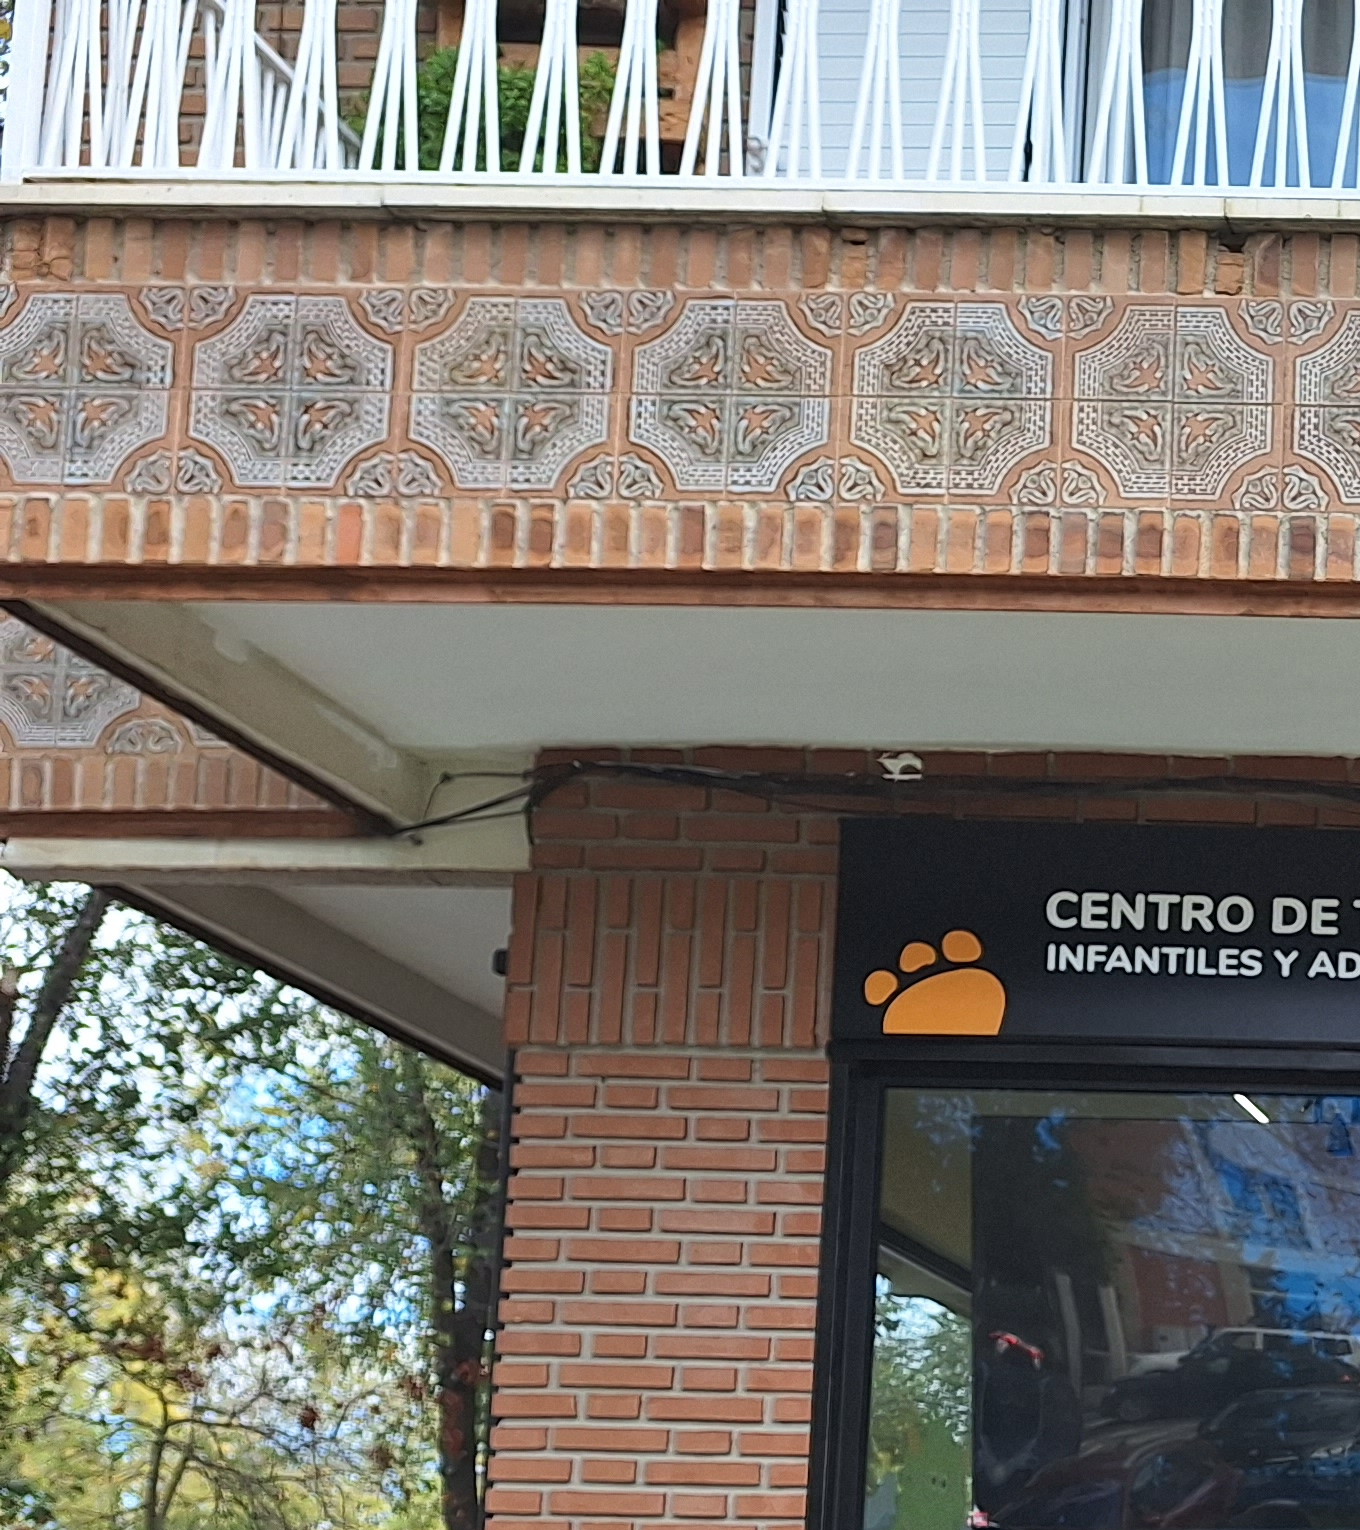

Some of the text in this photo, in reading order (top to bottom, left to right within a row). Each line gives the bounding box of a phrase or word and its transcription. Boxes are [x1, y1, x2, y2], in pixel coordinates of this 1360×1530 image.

[1045, 890, 1254, 934] CENTRO
[1272, 896, 1338, 937] DE
[1045, 943, 1263, 977] INFANTILES
[1274, 947, 1299, 978] Y
